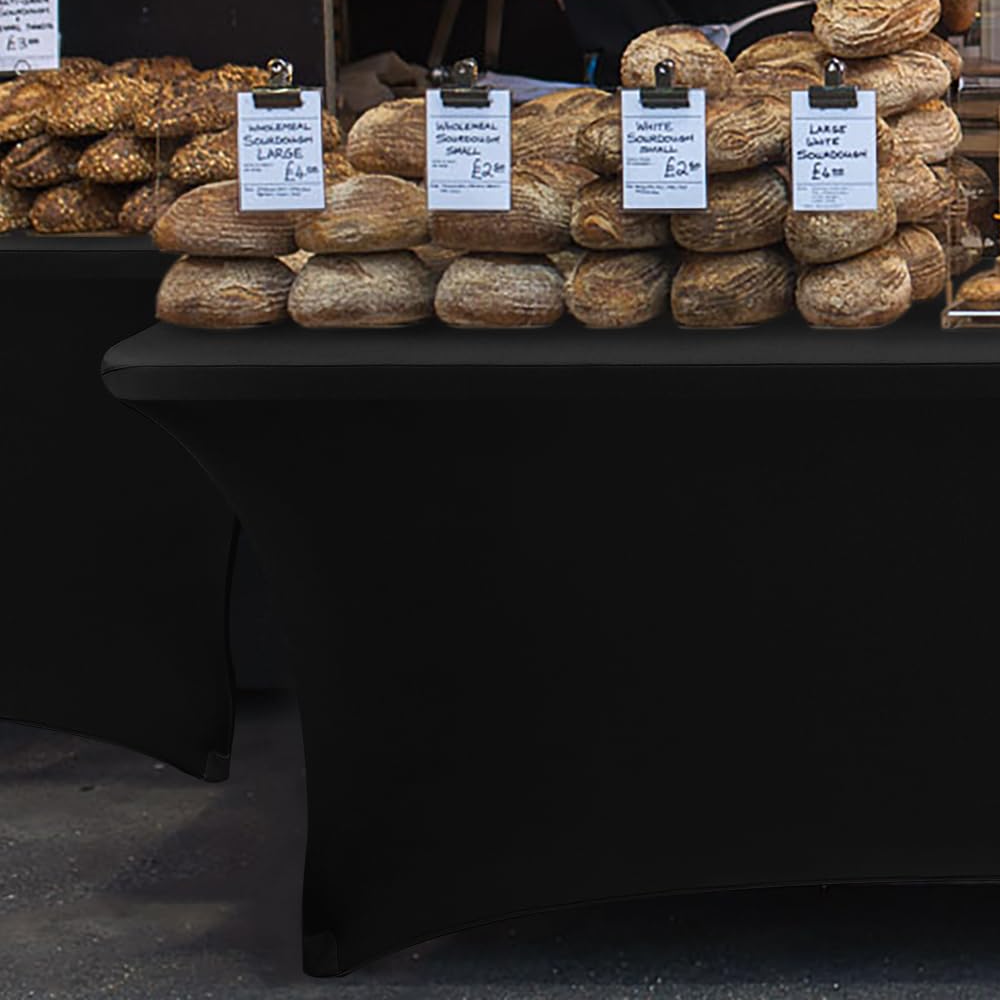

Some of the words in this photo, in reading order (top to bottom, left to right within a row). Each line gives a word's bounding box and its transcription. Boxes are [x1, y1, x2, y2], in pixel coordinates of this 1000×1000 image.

[248, 122, 312, 132] WHOLEMEAL
[435, 121, 499, 132] WHOLEMEAL
[635, 121, 674, 132] WHITE
[809, 124, 848, 135] LARGE
[243, 134, 314, 147] SOURDOUGH
[435, 133, 501, 144] SOURDOUGH
[626, 133, 695, 144] SOURDOUGH
[256, 147, 305, 161] LARGE
[445, 146, 482, 156] SMALL
[639, 146, 679, 154] SMALL
[796, 149, 868, 160] SOURDOUGH
